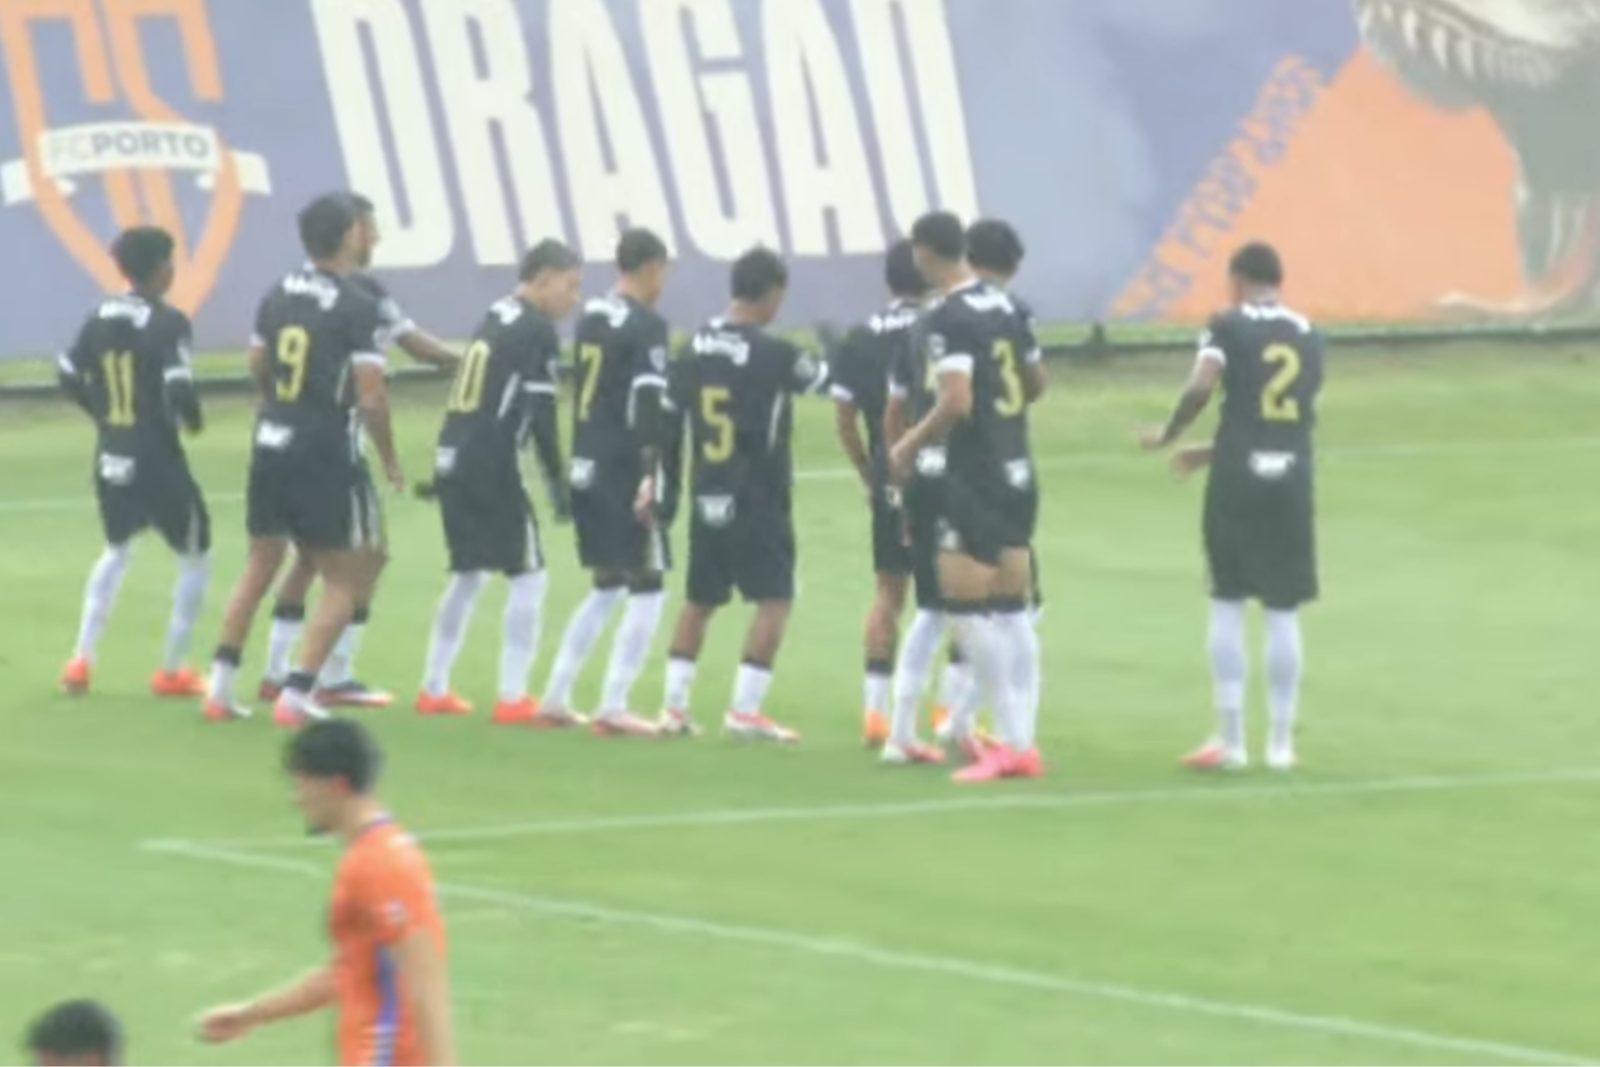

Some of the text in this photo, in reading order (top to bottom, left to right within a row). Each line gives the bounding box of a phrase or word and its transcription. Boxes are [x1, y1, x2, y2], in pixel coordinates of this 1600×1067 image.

[101, 349, 136, 427] 11
[275, 325, 310, 402] 9
[578, 344, 603, 422] 7
[991, 339, 1023, 417] 3
[1261, 343, 1299, 421] 2
[701, 386, 735, 462] 5
